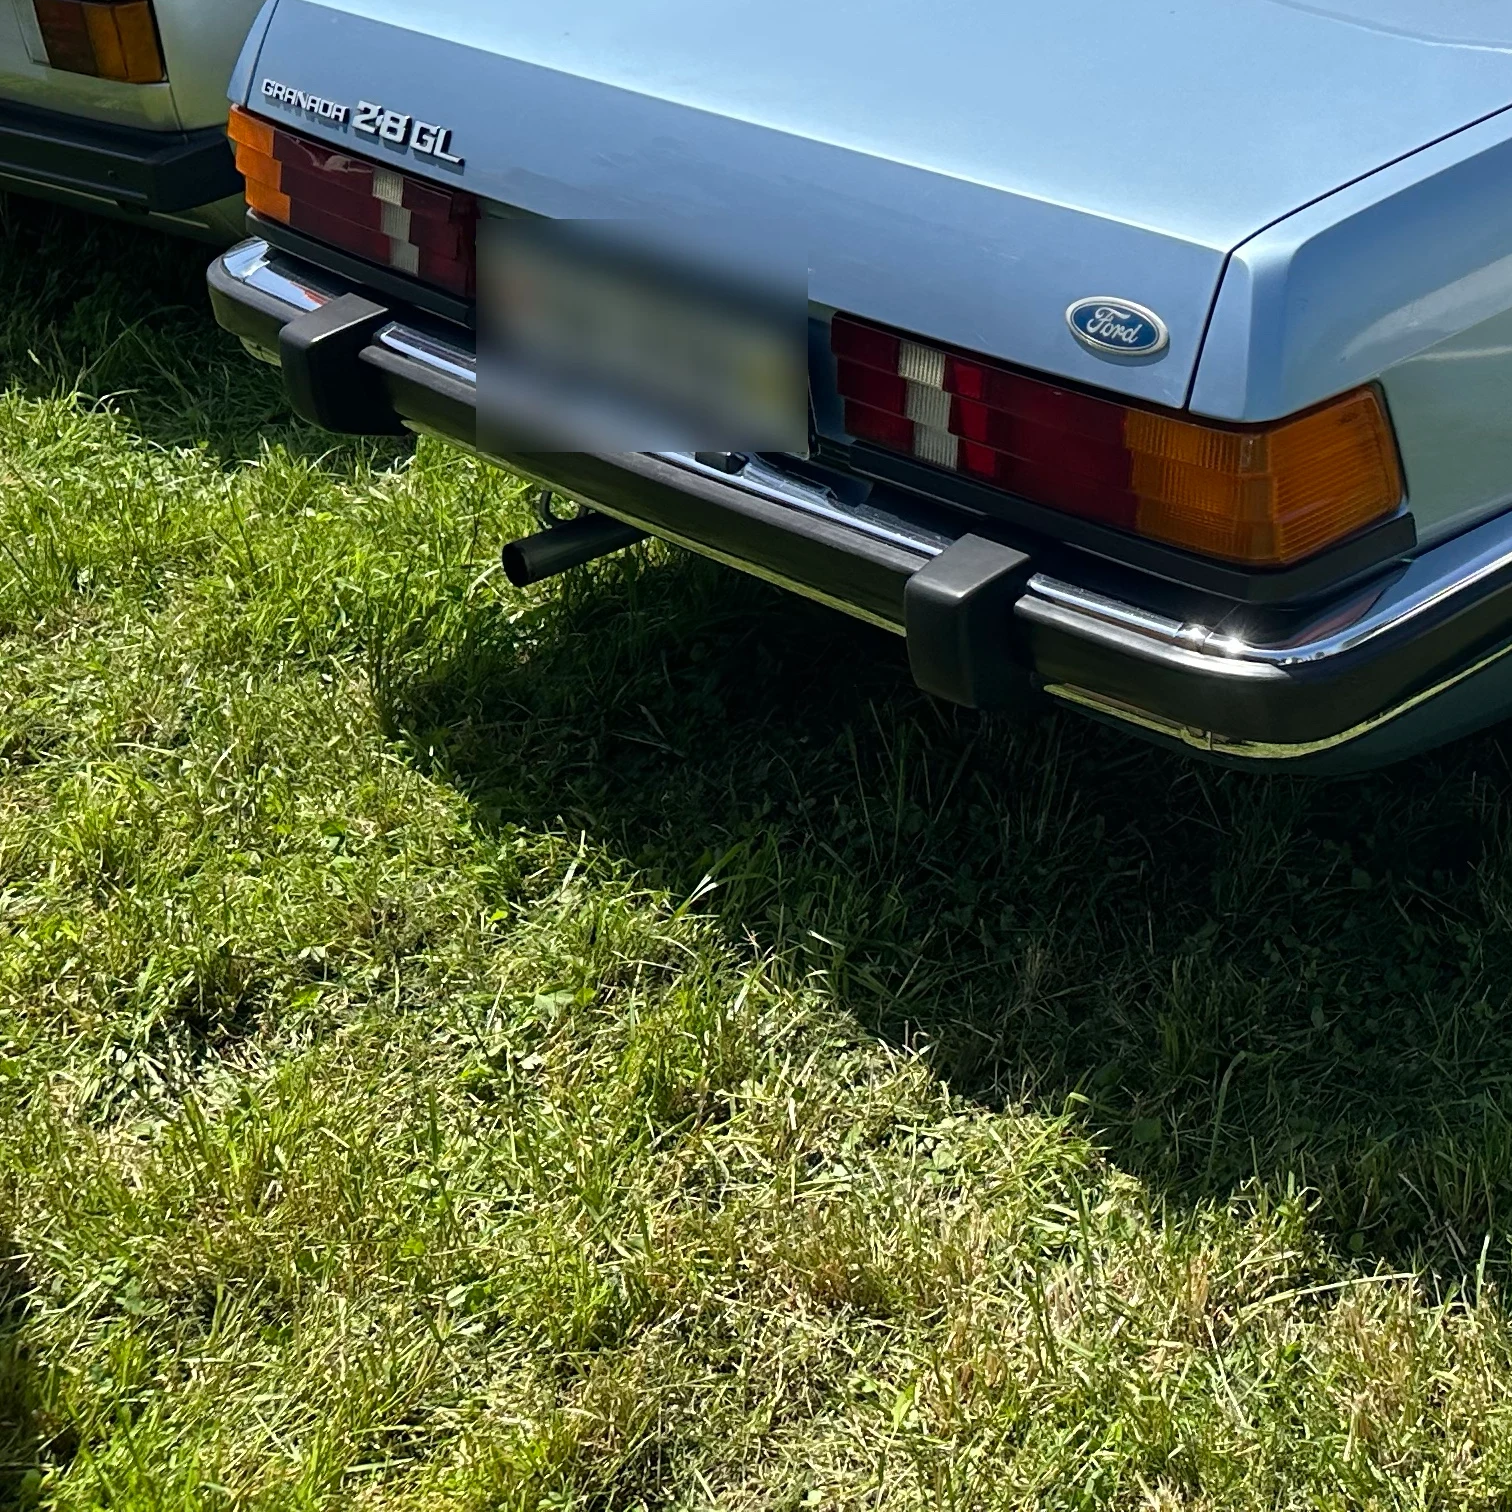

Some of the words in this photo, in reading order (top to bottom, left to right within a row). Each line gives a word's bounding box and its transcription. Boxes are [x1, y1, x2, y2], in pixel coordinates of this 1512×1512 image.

[261, 78, 349, 123] GRANADA
[410, 120, 465, 164] GL
[1086, 306, 1143, 344] Ford
